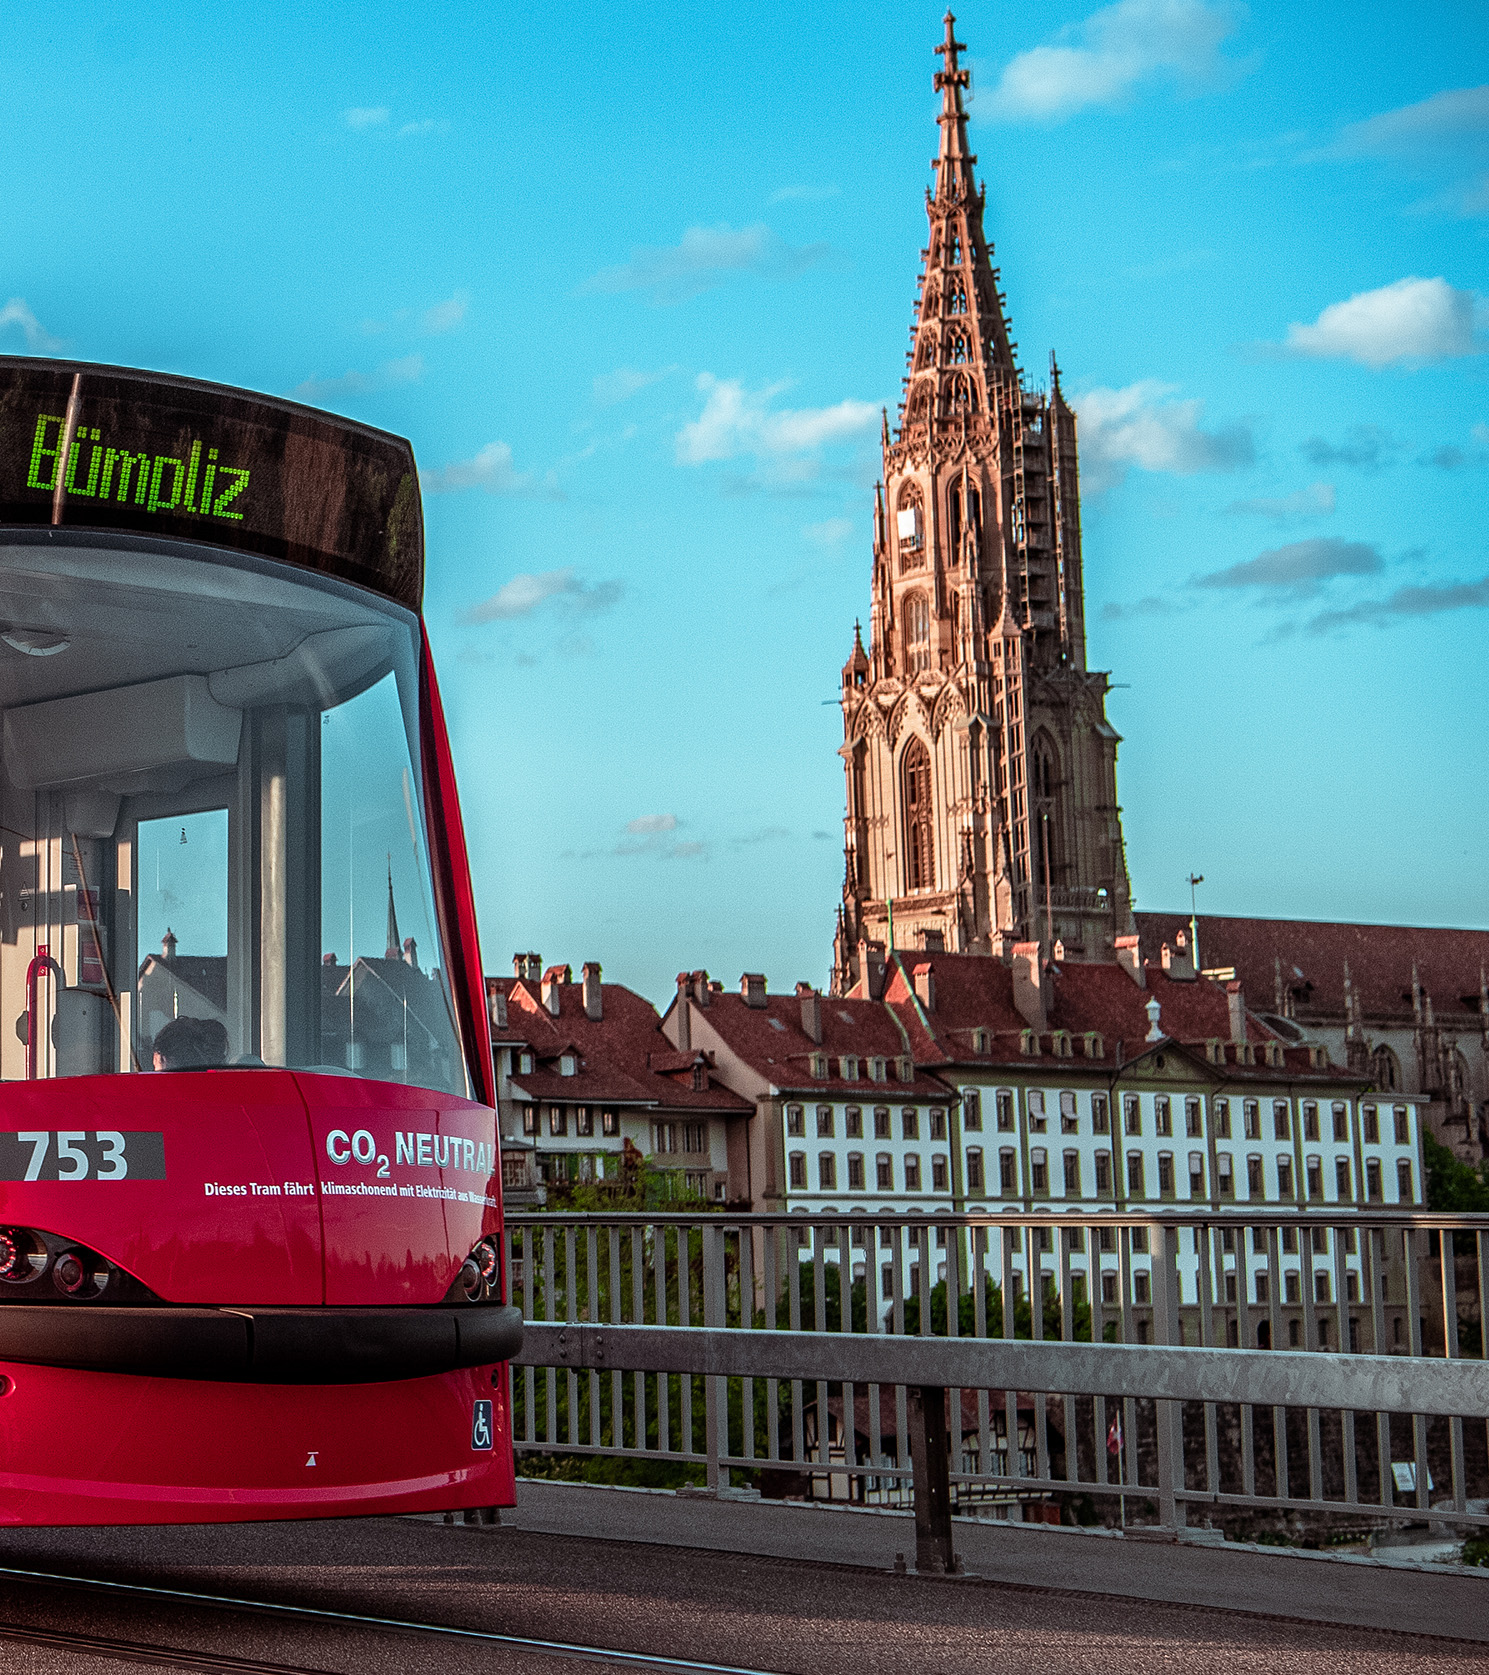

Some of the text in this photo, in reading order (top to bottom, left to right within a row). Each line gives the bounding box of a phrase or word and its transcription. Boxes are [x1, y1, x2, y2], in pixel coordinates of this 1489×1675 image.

[27, 413, 250, 520] Bümpliz
[16, 1130, 129, 1182] 753
[395, 1131, 495, 1175] NEUTRAL
[204, 1181, 247, 1196] Dieses
[249, 1182, 282, 1196] Tram
[283, 1181, 315, 1196] fährt
[320, 1181, 396, 1197] klimaschonend
[399, 1184, 414, 1198] mit
